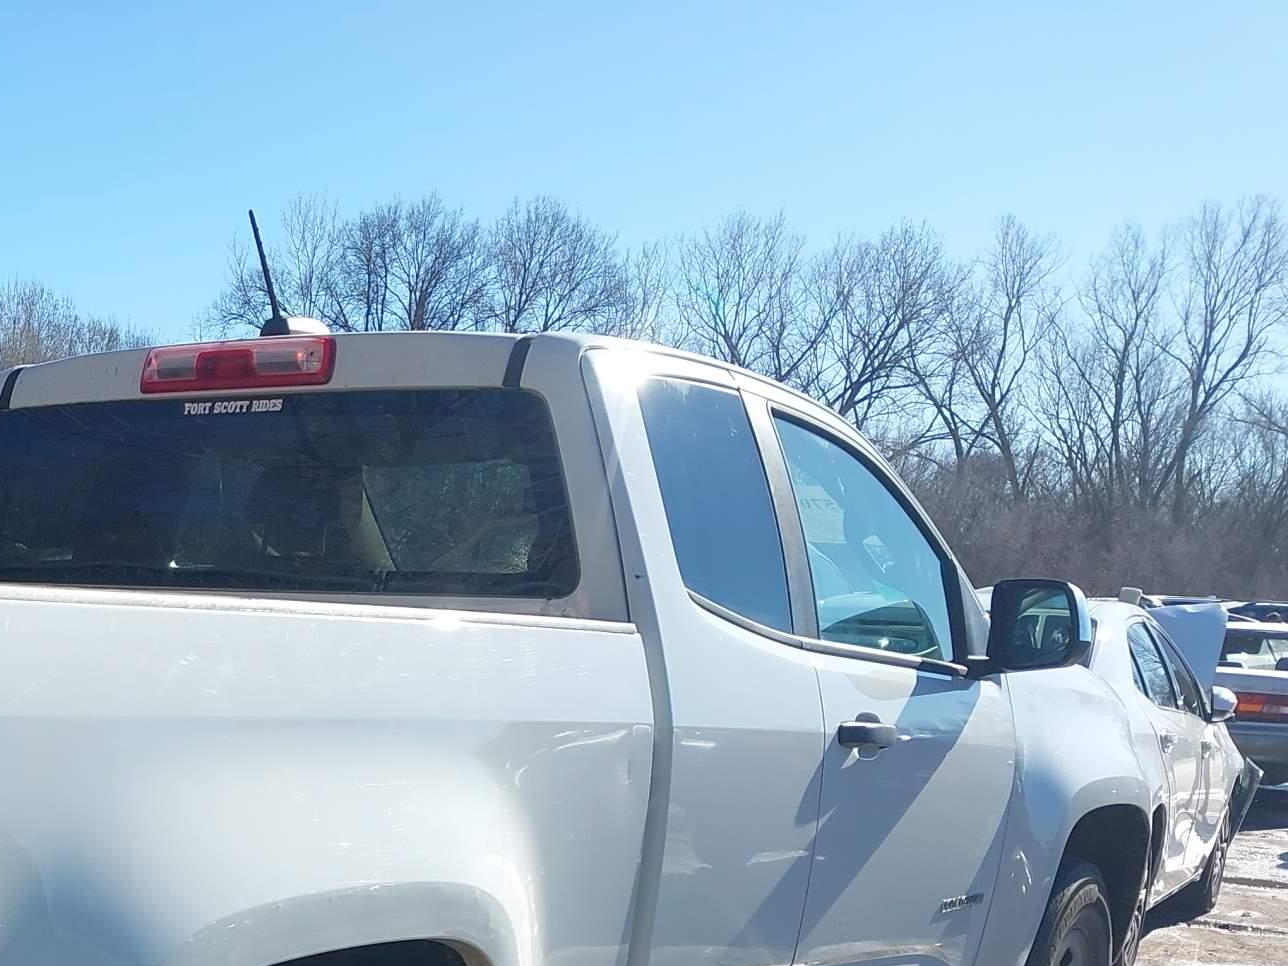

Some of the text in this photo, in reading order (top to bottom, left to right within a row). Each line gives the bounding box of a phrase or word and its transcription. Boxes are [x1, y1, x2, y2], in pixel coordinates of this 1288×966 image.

[184, 399, 283, 415] FORT SCOTT RIDES
